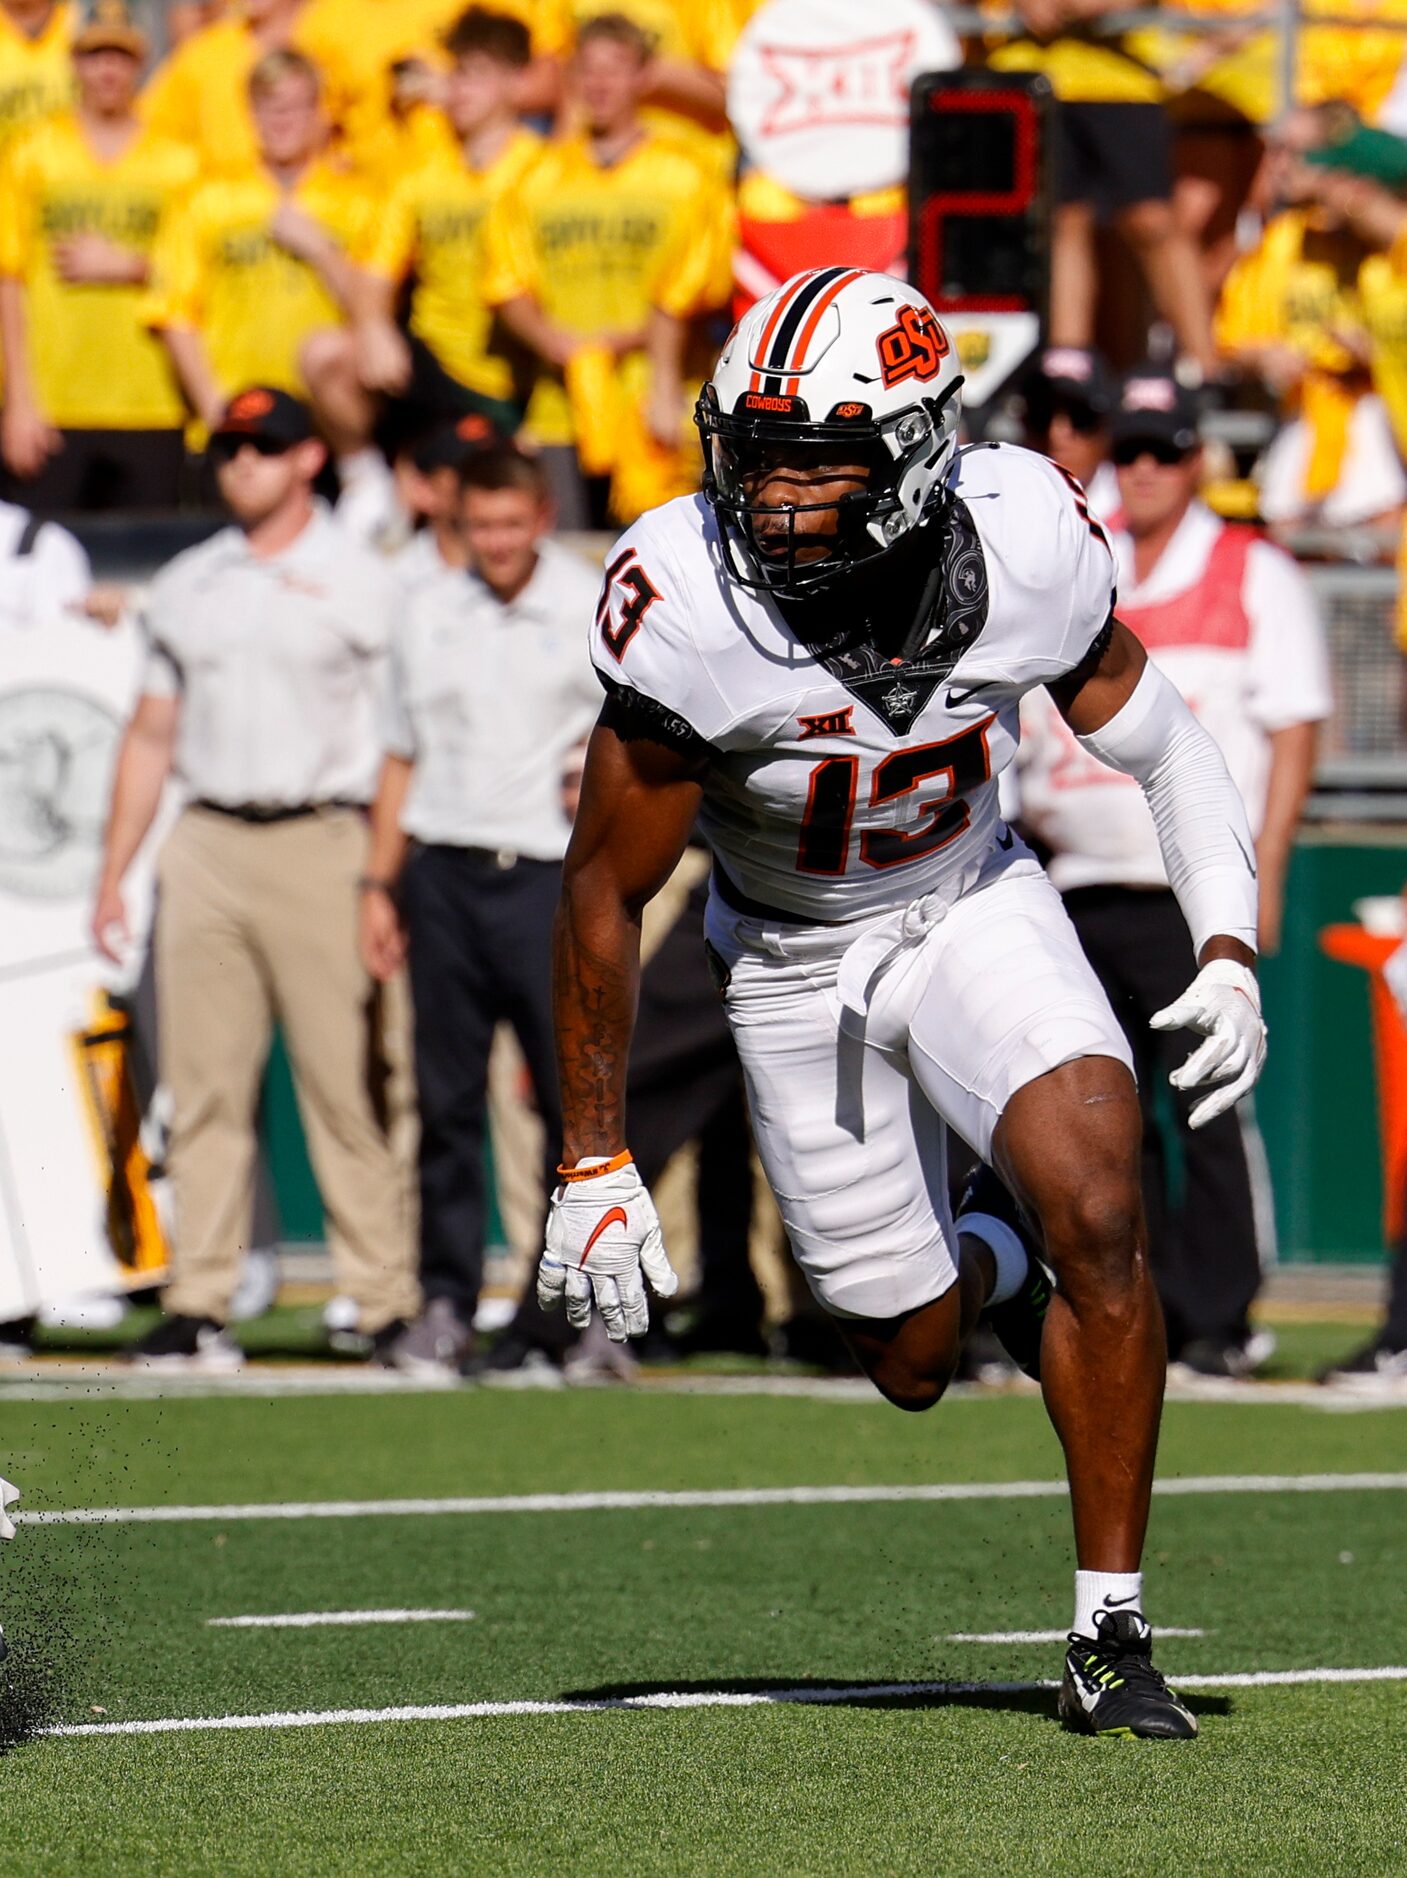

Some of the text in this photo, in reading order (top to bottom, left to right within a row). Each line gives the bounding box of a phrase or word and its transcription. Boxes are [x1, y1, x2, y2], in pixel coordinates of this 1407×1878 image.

[920, 88, 1037, 313] 2
[876, 303, 950, 390] OSU
[745, 394, 793, 413] COWBOYS
[595, 547, 665, 665] 13
[796, 704, 857, 741] XII
[795, 711, 999, 876] 13
